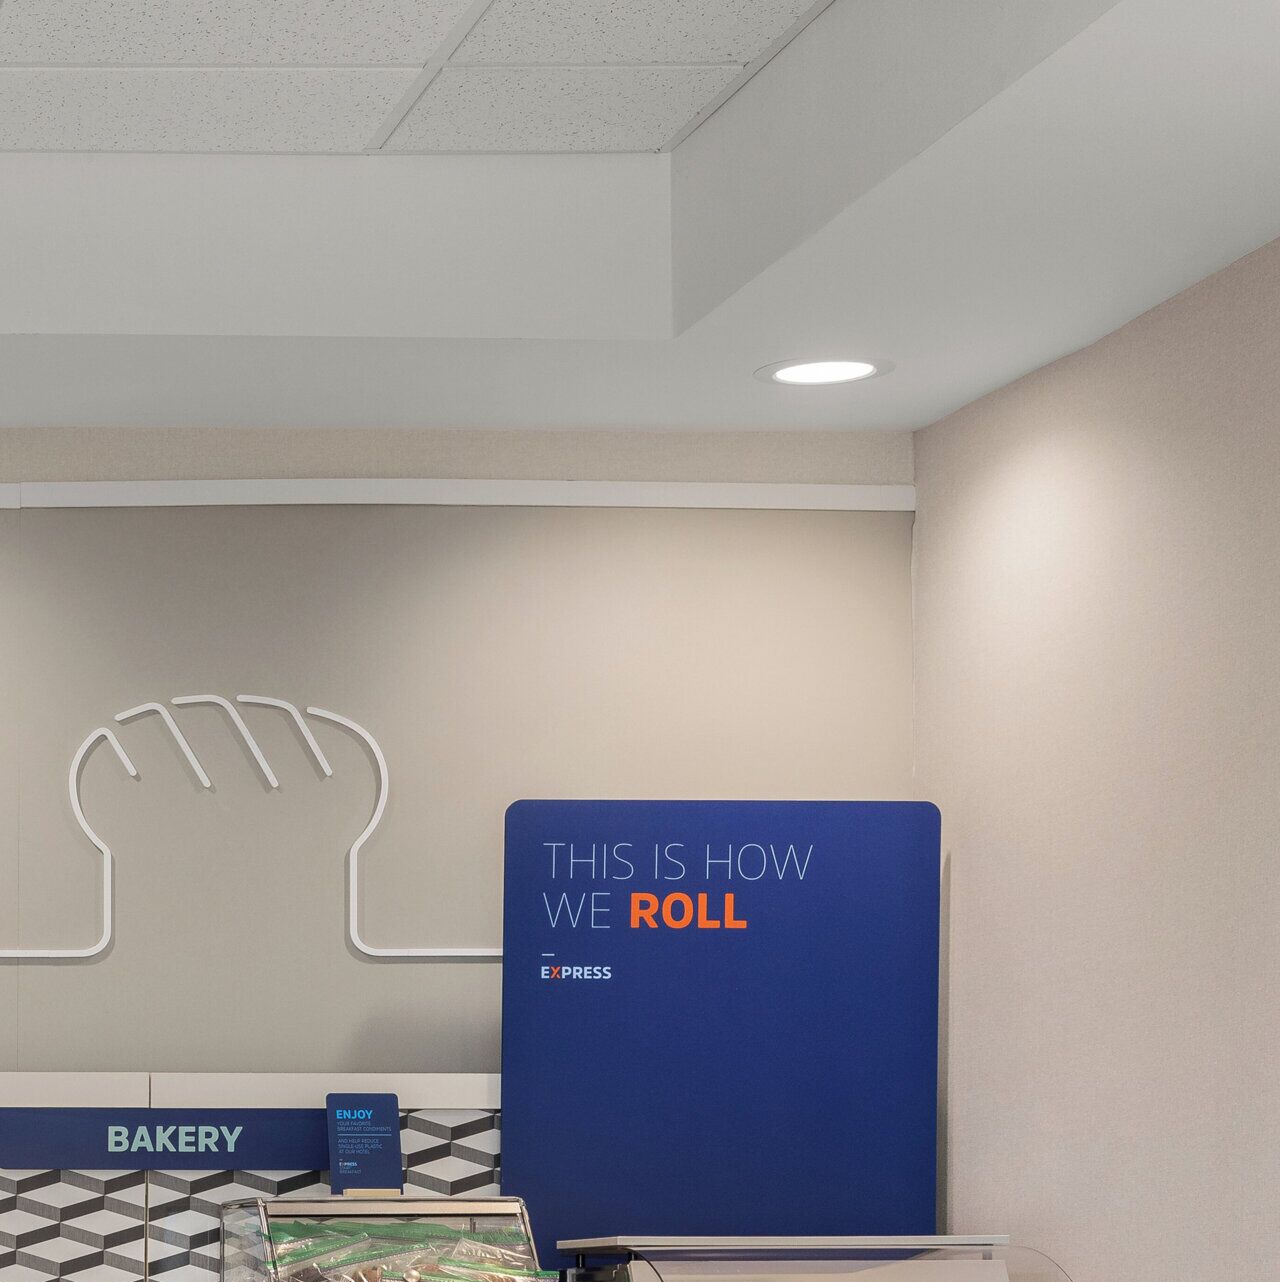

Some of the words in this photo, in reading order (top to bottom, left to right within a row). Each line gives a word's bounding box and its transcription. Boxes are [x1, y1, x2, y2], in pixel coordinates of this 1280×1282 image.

[542, 843, 634, 880] THIS
[654, 843, 686, 880] IS
[705, 843, 814, 880] HOW
[542, 892, 611, 929] WE
[630, 892, 747, 929] ROLL
[541, 966, 612, 980] EXPRESS
[336, 1110, 373, 1119] ENJOY
[107, 1125, 243, 1153] BAKERY
